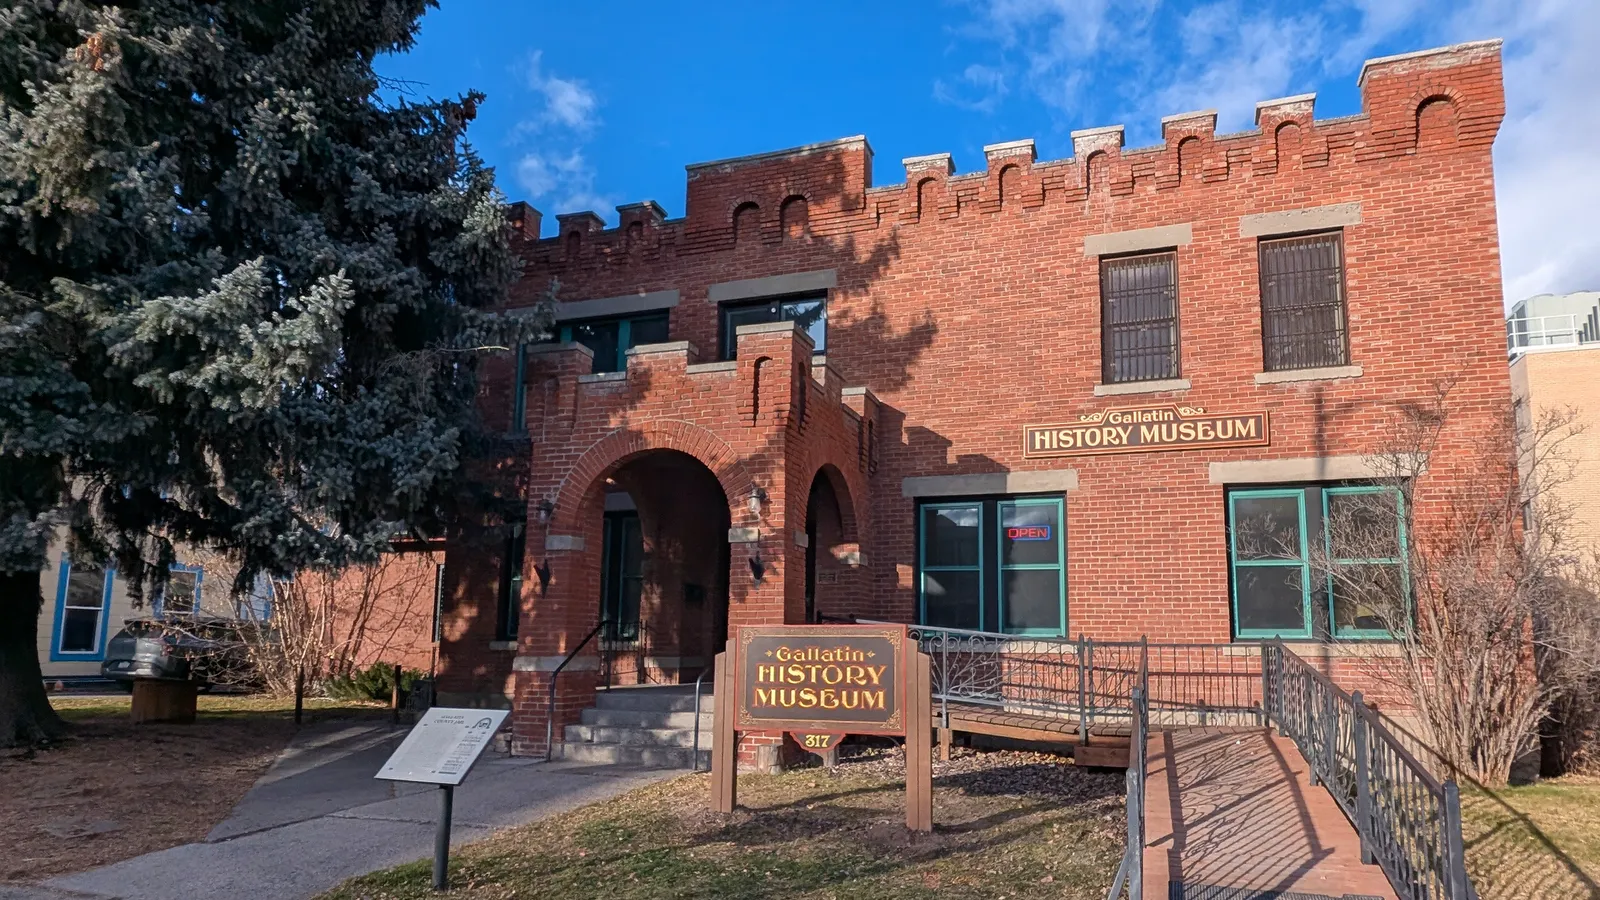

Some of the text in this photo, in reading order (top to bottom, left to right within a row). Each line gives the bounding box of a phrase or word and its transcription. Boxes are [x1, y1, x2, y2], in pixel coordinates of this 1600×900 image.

[1109, 410, 1174, 425] Gallatin
[1034, 418, 1257, 450] HISTORY MUSEUM
[1008, 528, 1047, 538] OPEN
[776, 646, 865, 663] Gallatin
[757, 664, 888, 686] HISTORY
[753, 687, 887, 710] MUSEUM
[805, 734, 831, 749] 317
